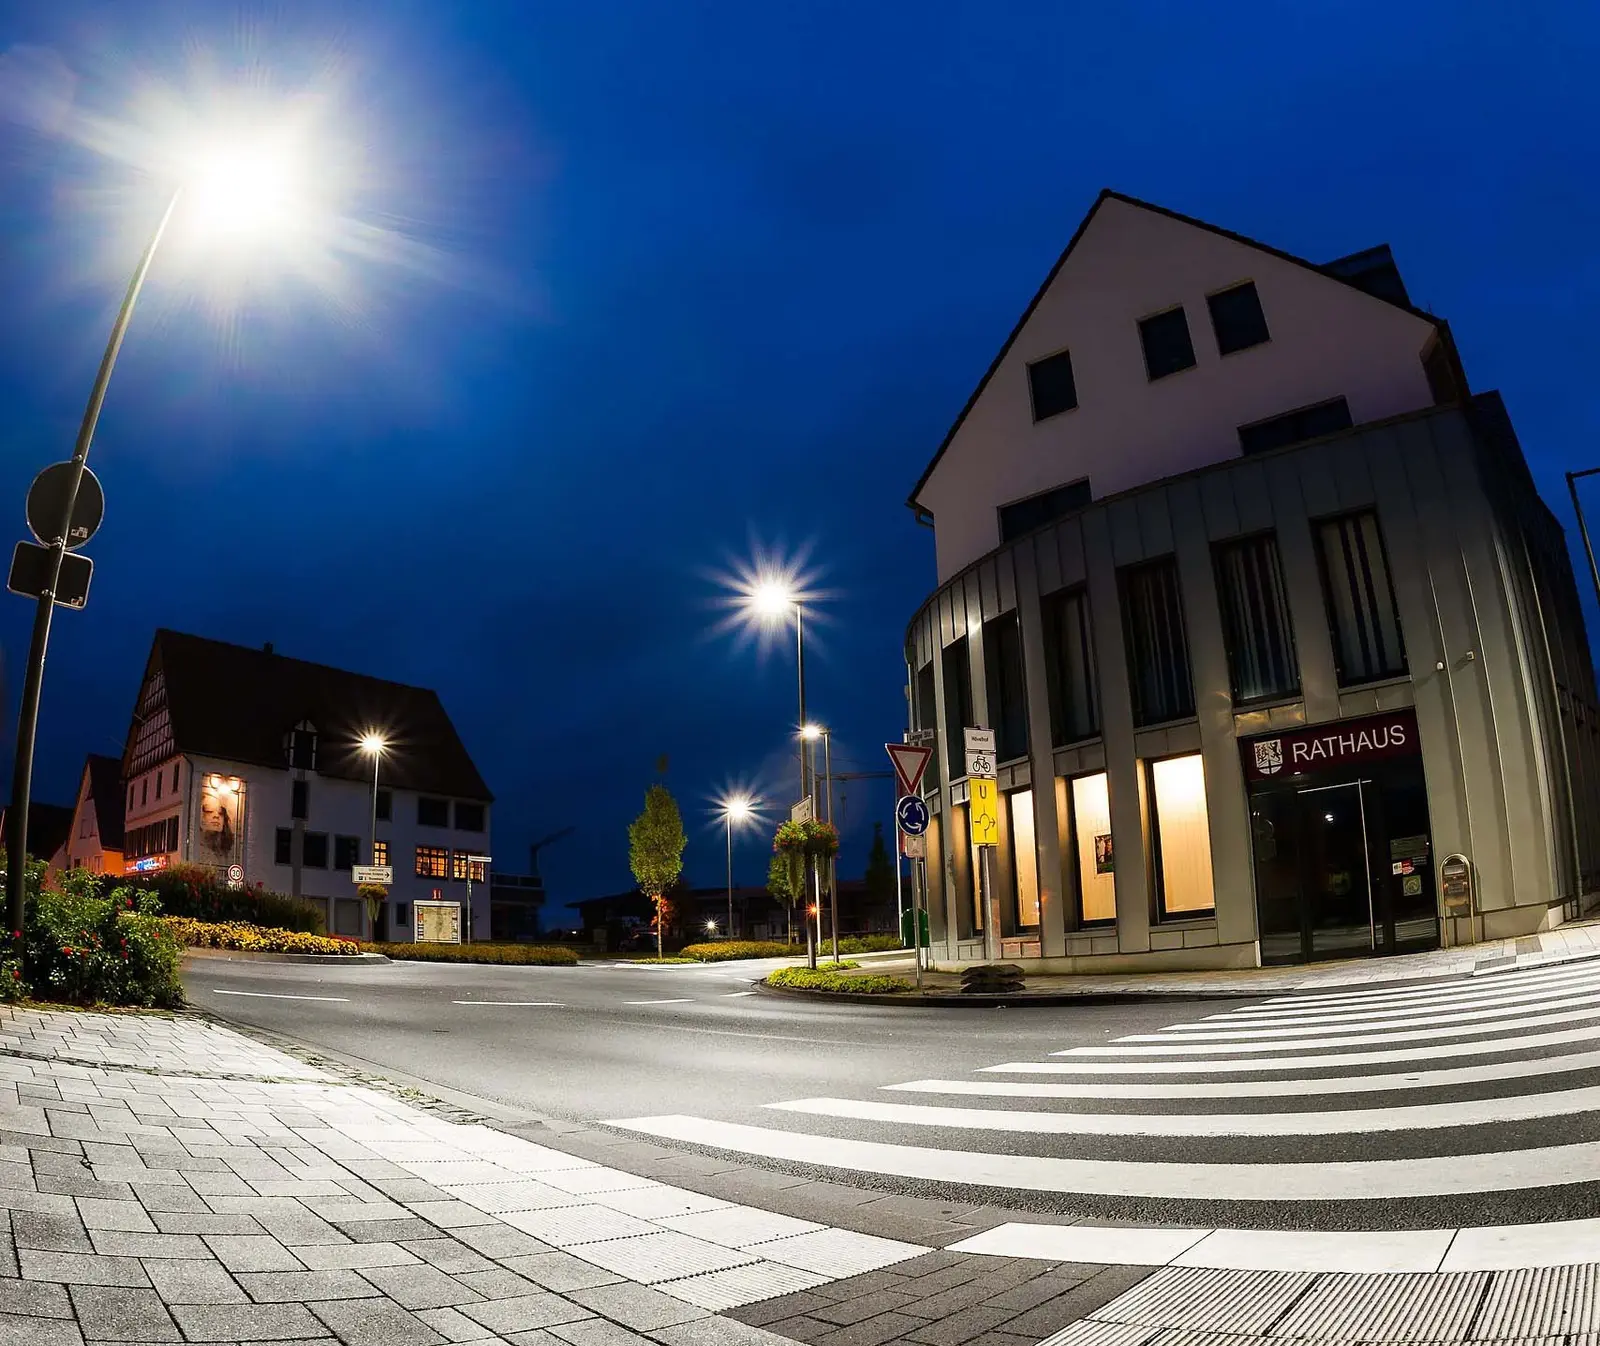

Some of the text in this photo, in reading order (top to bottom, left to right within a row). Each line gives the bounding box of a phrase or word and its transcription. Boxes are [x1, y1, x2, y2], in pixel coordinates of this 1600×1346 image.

[1292, 724, 1406, 763] RATHAUS
[979, 784, 987, 800] U
[231, 869, 240, 878] 30
